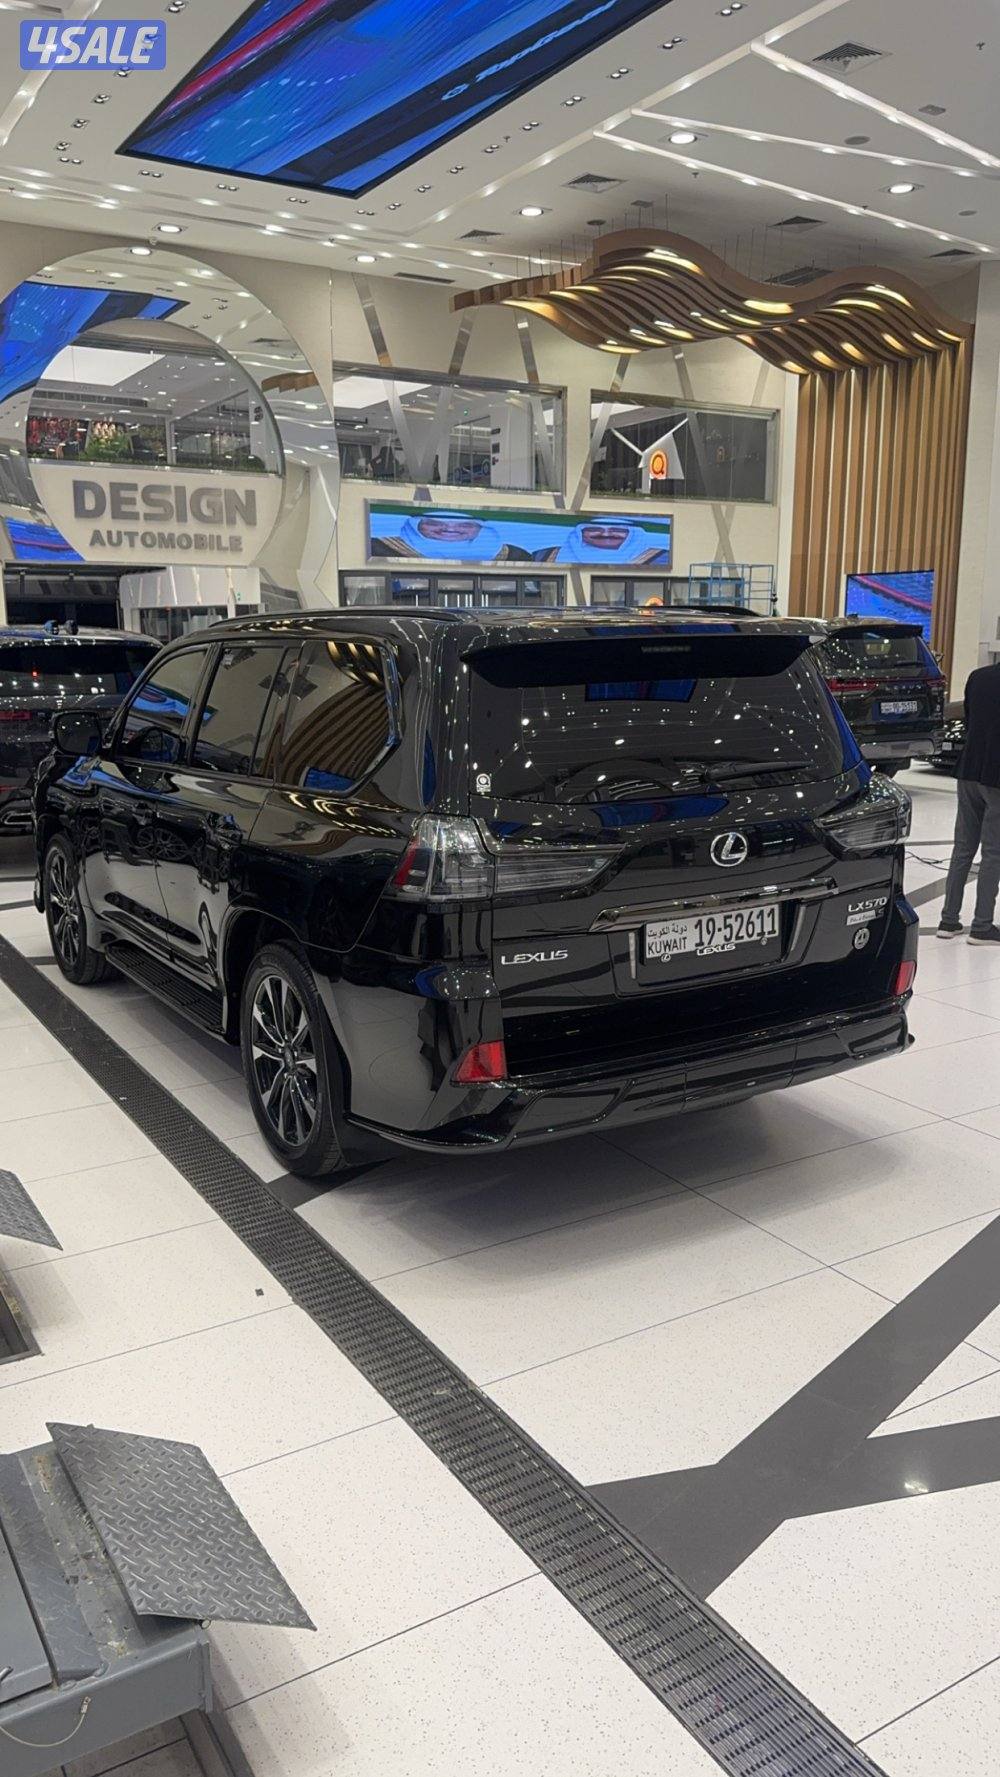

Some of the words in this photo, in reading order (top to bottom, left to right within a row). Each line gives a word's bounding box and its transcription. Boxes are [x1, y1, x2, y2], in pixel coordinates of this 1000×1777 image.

[72, 479, 257, 527] DESIGN
[89, 529, 244, 552] AUTOMOBILE
[647, 926, 671, 939] الكويت
[671, 923, 688, 936] دولة
[694, 907, 777, 947] 19-52611
[647, 936, 688, 956] KUWAIT
[697, 943, 736, 956] LEXUS
[501, 949, 569, 966] LEXUS
